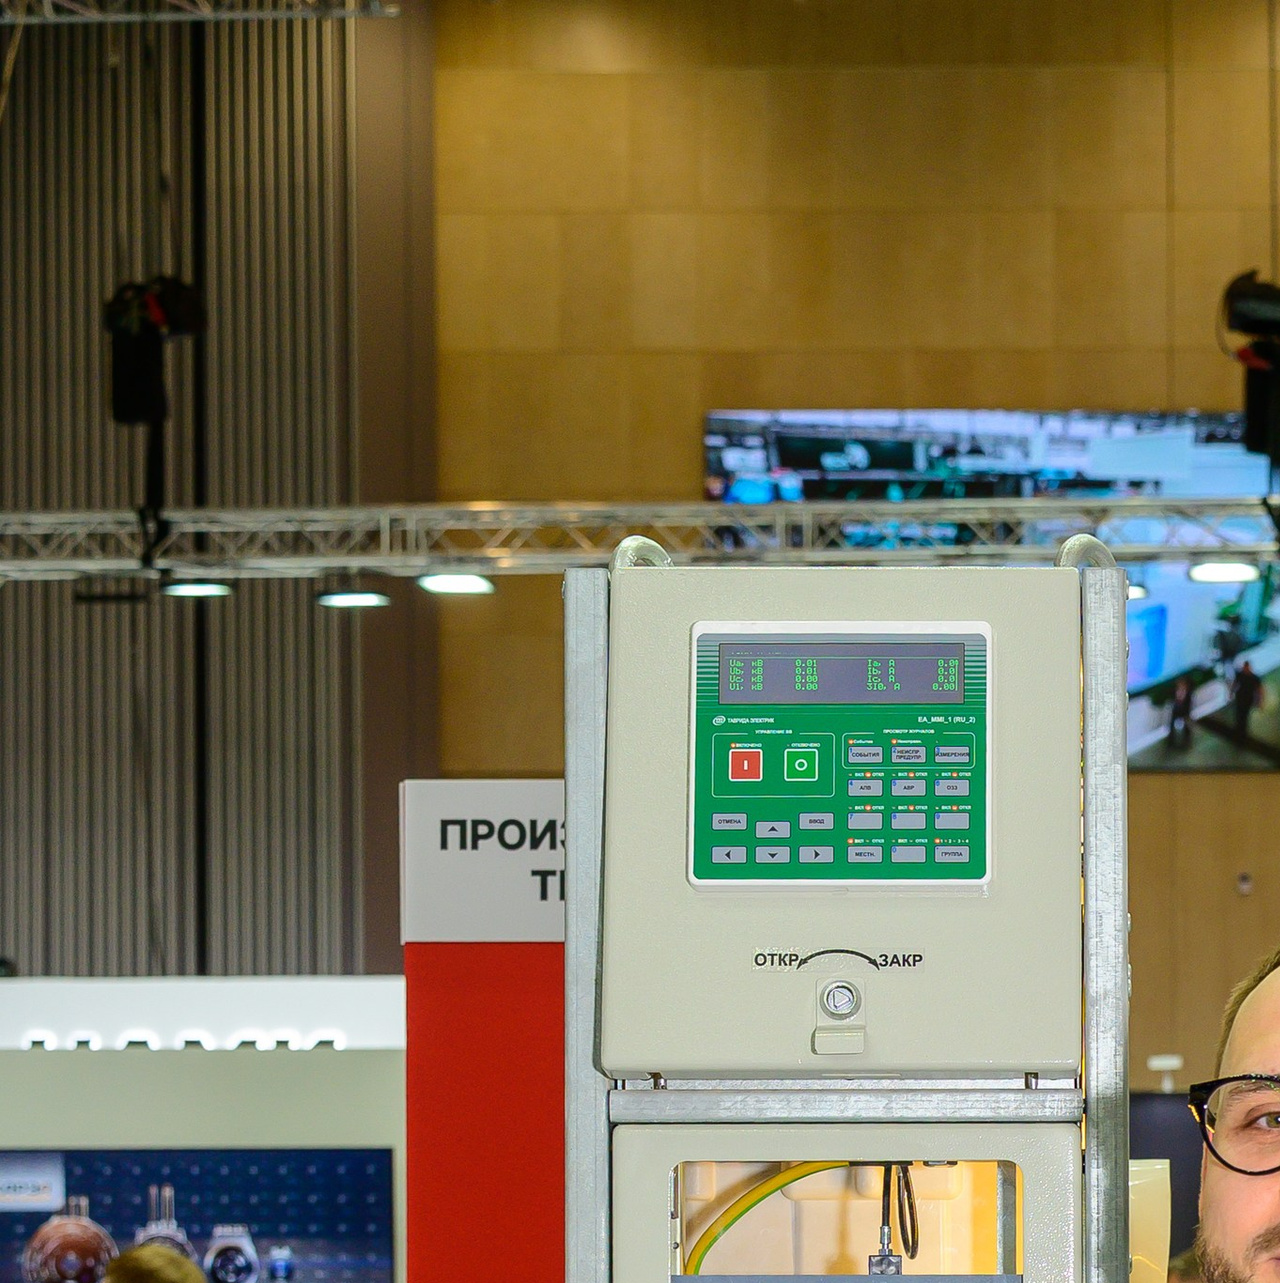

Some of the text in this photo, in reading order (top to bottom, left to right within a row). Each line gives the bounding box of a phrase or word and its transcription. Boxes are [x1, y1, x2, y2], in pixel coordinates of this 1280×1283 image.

[918, 716, 976, 724] EA_MMI_1 (RU_2)
[440, 819, 566, 850] ПРОИ
[754, 953, 799, 967] ОТКР
[878, 953, 923, 967] ЗАКР
